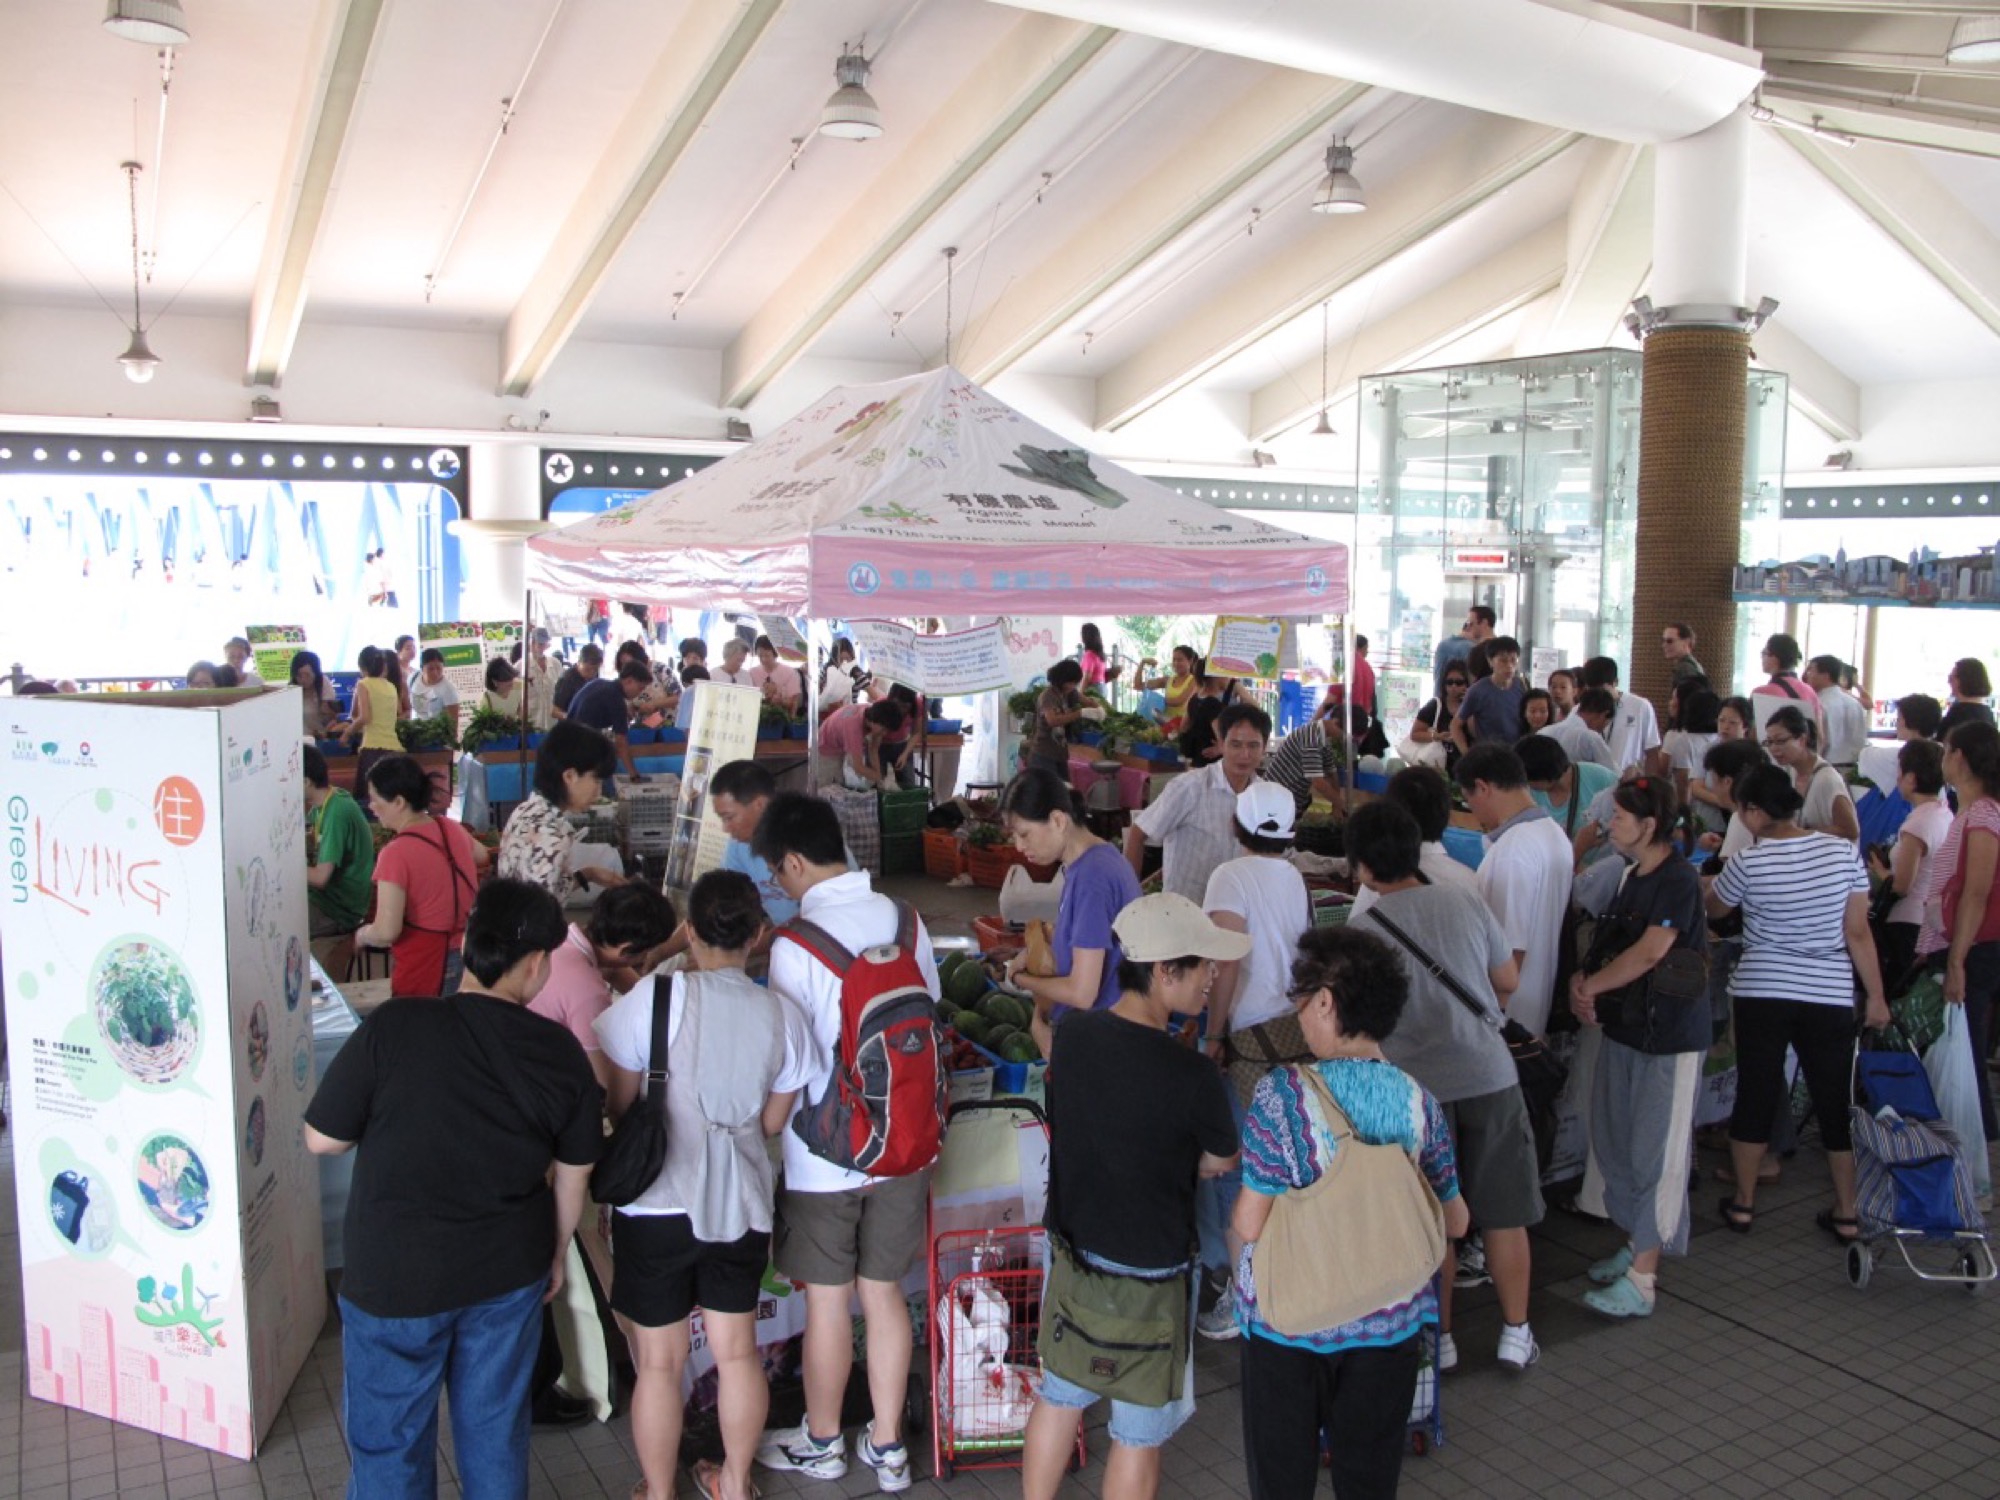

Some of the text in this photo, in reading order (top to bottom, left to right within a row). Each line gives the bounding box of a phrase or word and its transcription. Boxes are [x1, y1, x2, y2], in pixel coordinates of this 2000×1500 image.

[7, 794, 30, 904] Green
[156, 787, 195, 840] 住
[33, 815, 171, 916] LIVING
